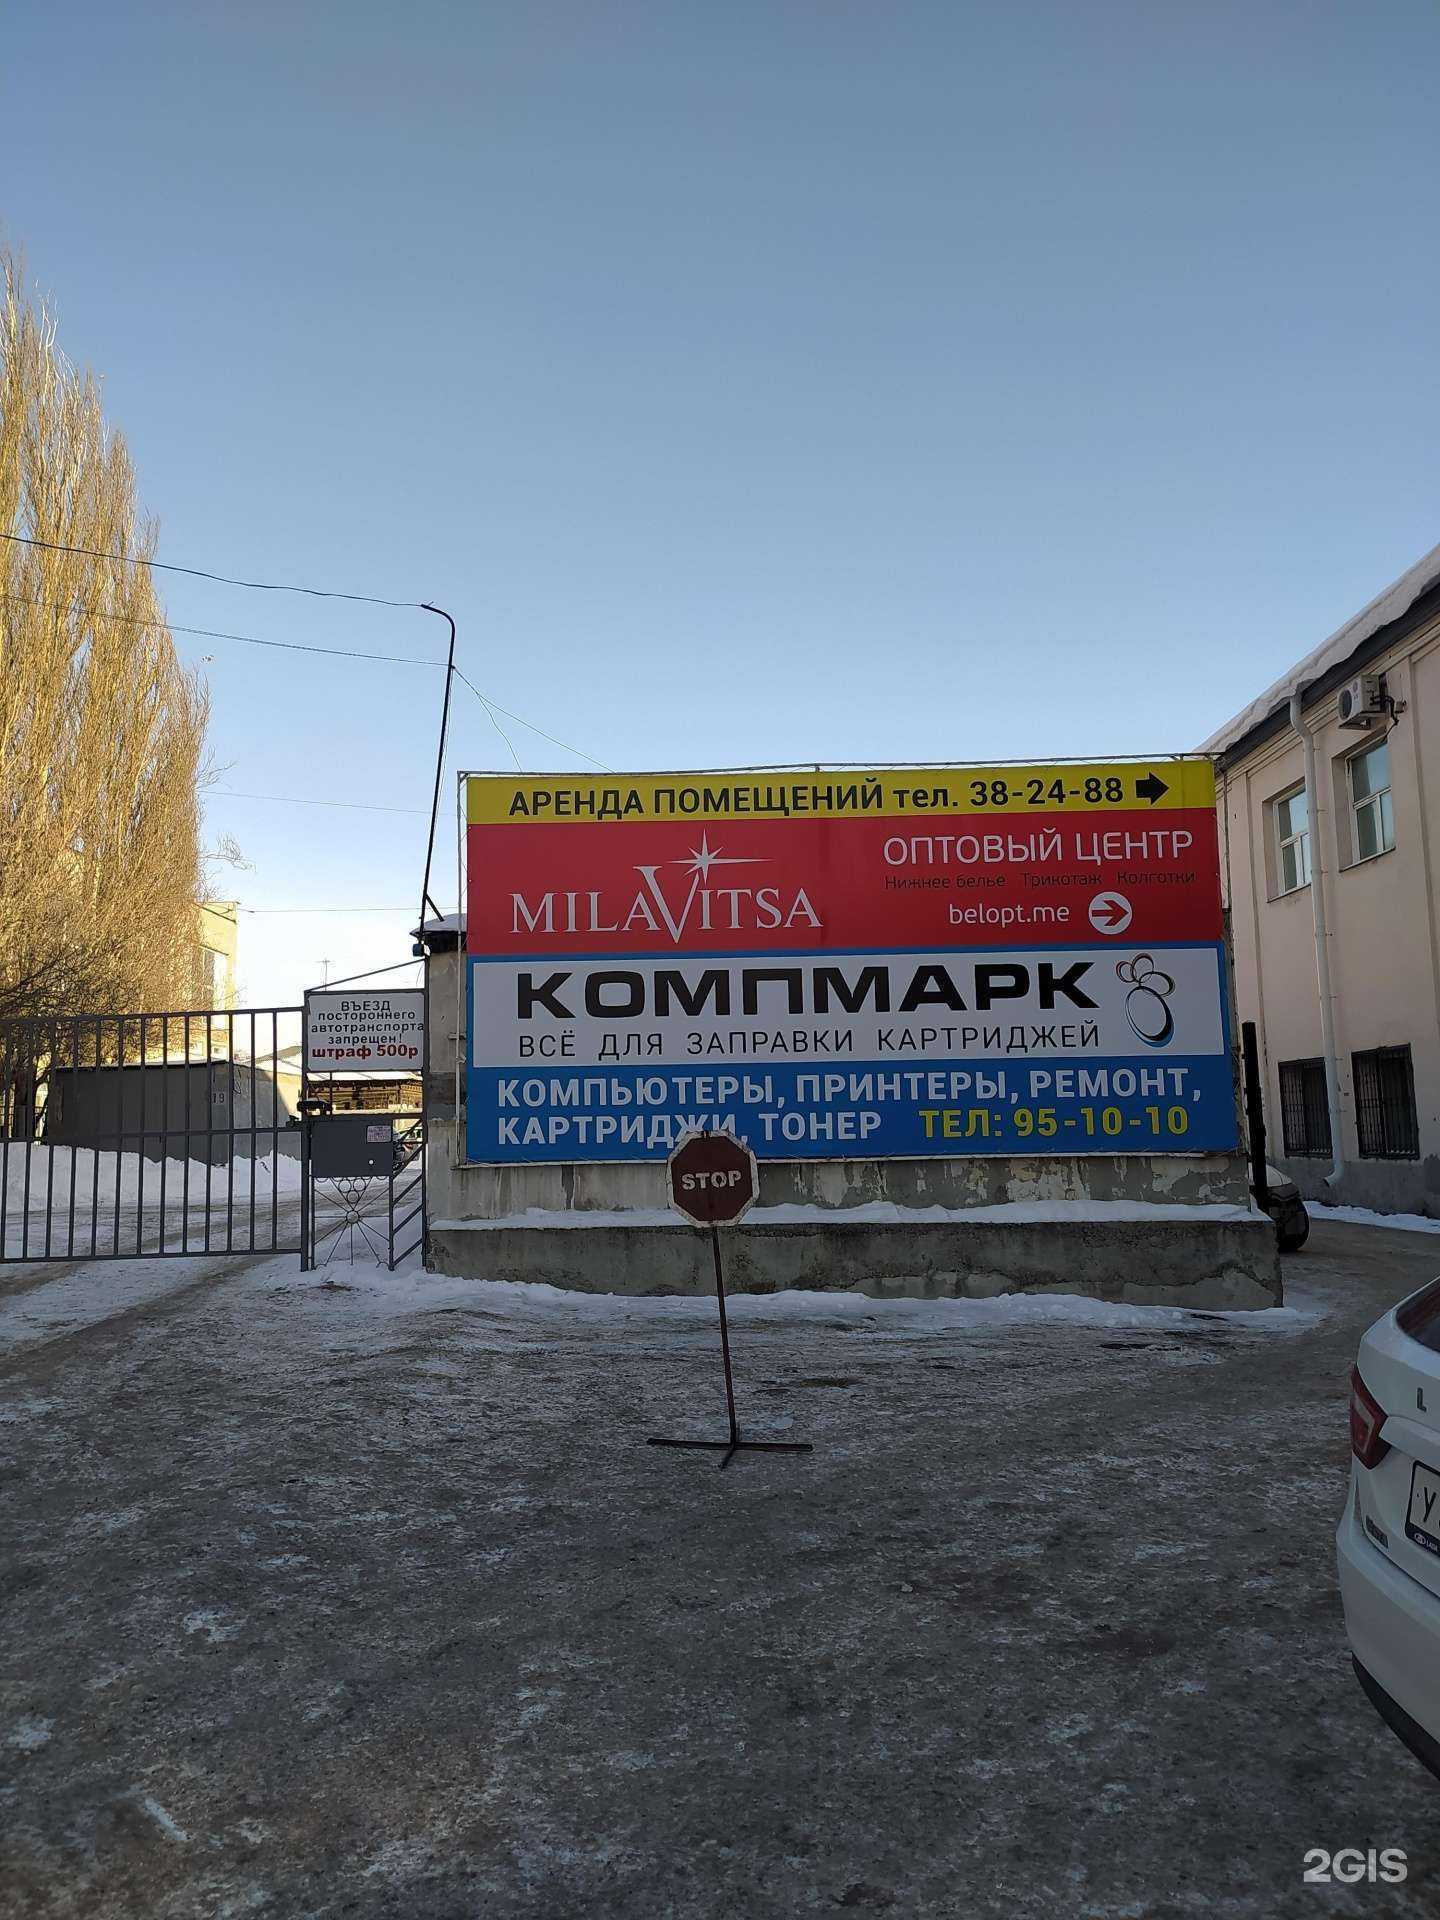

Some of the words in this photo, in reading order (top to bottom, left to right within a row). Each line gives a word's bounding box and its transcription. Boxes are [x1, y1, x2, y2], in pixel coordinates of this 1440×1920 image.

[509, 788, 644, 820] АРЕНДА
[654, 777, 883, 816] ПОМЕЩЕНИЙ
[893, 788, 959, 809] тел.
[969, 777, 1123, 806] 38-24-88
[883, 827, 1062, 866] ОПТОВЫЙ
[1075, 830, 1194, 866] ЦЕНТР
[885, 875, 950, 889] Нижнее
[956, 873, 1006, 888] белье
[1021, 872, 1102, 889] Трикотаж
[1117, 871, 1196, 886] Колготки
[507, 865, 824, 944] MILAVITSA
[949, 903, 1070, 928] belopt.me
[517, 961, 1100, 1019] КОМПМАРК
[318, 1011, 416, 1022] постороннего
[341, 1001, 391, 1013] ВЪЕЗД
[311, 1022, 424, 1034] автотранспорта
[328, 1034, 402, 1046] запрещен!
[519, 1030, 576, 1057] ВСЁ
[598, 1033, 663, 1061] ДЛЯ
[687, 1030, 853, 1055] ЗАПРАВКИ
[878, 1020, 1100, 1054] КАРТРИДЖЕЙ
[312, 1045, 371, 1060] штраф
[377, 1044, 418, 1060] 500р
[498, 1075, 786, 1109] КОМПЬЮТЕРЫ,
[797, 1070, 1018, 1105] ПРИНТЕРЫ,
[1030, 1068, 1202, 1102] РЕМОНТ,
[758, 1111, 882, 1141] ТОНЕР
[918, 1110, 1002, 1138] ТЕЛ:
[1013, 1106, 1189, 1136] 95-10-10
[681, 1170, 742, 1191] STOP
